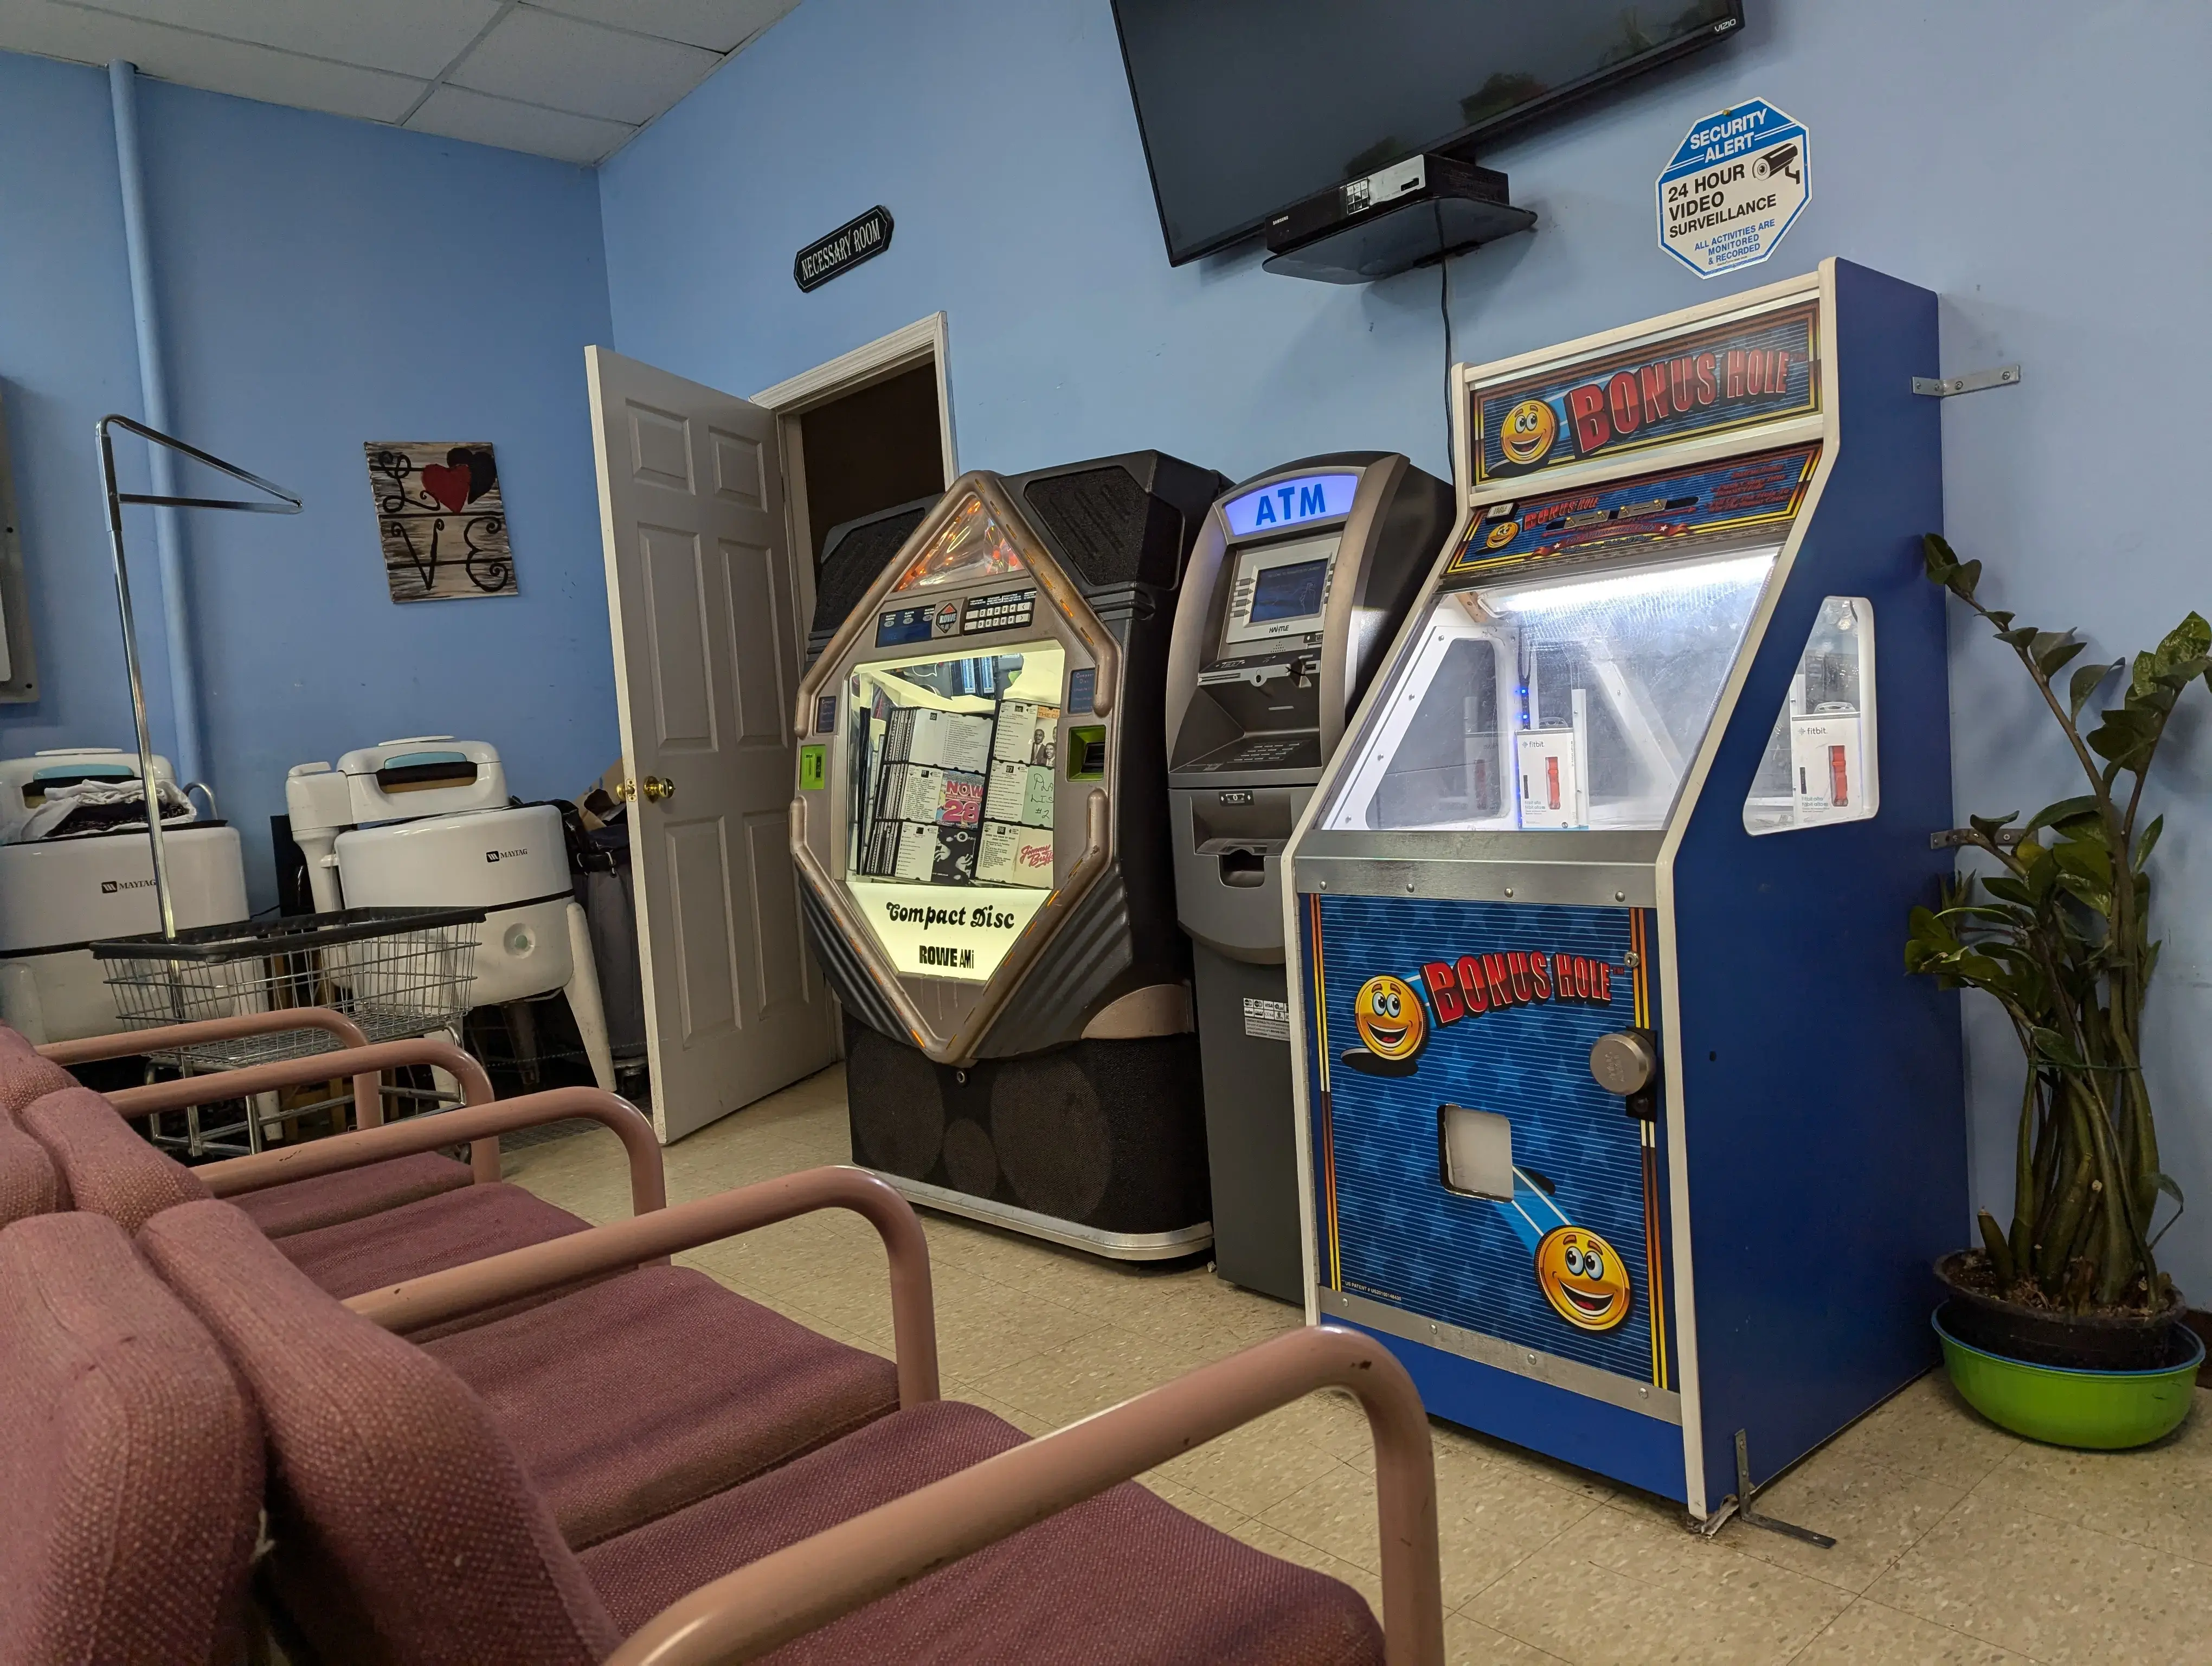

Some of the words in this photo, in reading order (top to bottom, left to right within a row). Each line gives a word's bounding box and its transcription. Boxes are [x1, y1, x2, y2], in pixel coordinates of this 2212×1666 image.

[1714, 18, 1736, 32] VIZIO
[1690, 108, 1767, 150] SECURITY
[1705, 132, 1754, 163] ALERT
[1668, 182, 1688, 203] 24
[1694, 163, 1745, 194] HOUR
[1669, 191, 1724, 221] VIDEO
[1669, 194, 1777, 239] SURVEILLANCE
[1272, 215, 1289, 226] SAMSUNG
[1694, 241, 1709, 251] ALL
[1711, 226, 1756, 246] ACTIVITIES
[1758, 219, 1776, 232] ARE
[1708, 234, 1759, 256] MONITORED
[801, 228, 852, 280] NECESSARY
[853, 218, 880, 253] ROOM
[1708, 257, 1714, 265] &
[1716, 243, 1760, 263] RECORDED
[1567, 352, 1716, 454] BONUS
[1724, 349, 1790, 400] HOLE
[1256, 483, 1326, 526] ATM
[1523, 500, 1577, 531] BONUS
[1577, 497, 1599, 511] HOLE
[939, 613, 956, 624] ROWE
[1269, 625, 1289, 633] HANTLE
[946, 780, 984, 798] NOW
[942, 799, 980, 823] 28
[500, 848, 528, 858] MAYTAG
[1020, 844, 1051, 864] Jimmy
[119, 879, 156, 890] MAYTAG
[886, 902, 966, 930] Compact
[970, 905, 1015, 928] Disc
[919, 945, 957, 967] ROWE
[1421, 951, 1550, 1027] BONUS
[1553, 953, 1612, 1004] HOLE
[1352, 1283, 1367, 1291] PATENT
